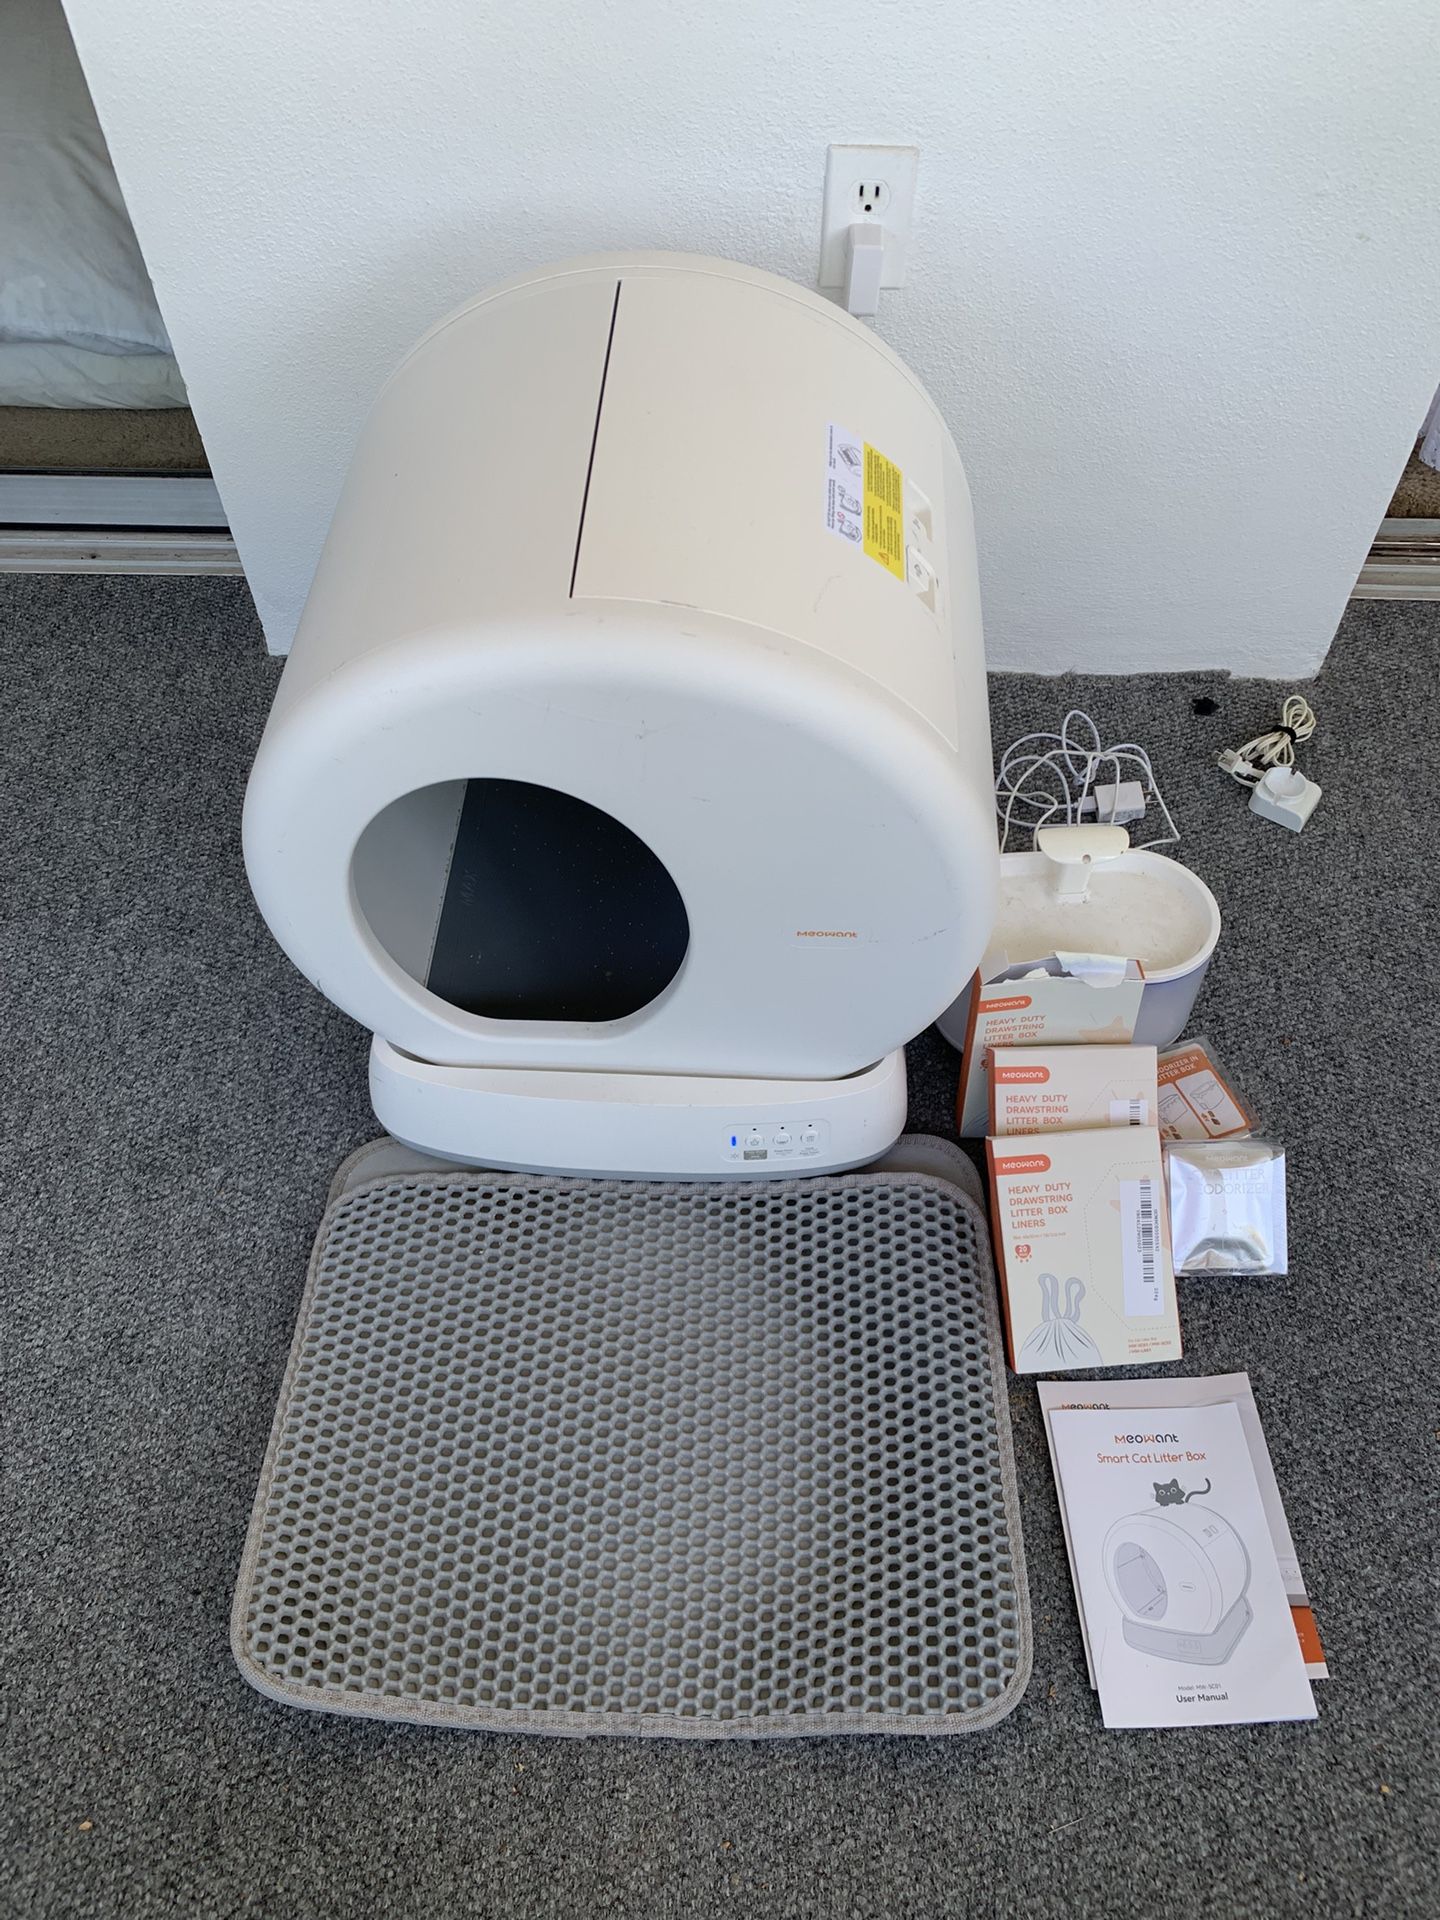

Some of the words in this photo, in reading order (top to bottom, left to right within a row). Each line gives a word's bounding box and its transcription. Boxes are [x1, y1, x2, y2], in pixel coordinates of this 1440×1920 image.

[986, 1017, 1016, 1026] HEAVY
[1021, 1015, 1046, 1023] DUTY
[985, 1023, 1045, 1034] DRAWSTRING
[984, 1033, 1014, 1042] LITTER
[1018, 1031, 1038, 1039] BOX
[1180, 1063, 1196, 1072] BOX
[1006, 1095, 1037, 1103] HEAVY
[1042, 1094, 1068, 1103] DUTY
[1006, 1105, 1069, 1114] DRAWSTRING
[1006, 1116, 1038, 1125] LITTER
[1043, 1116, 1063, 1125] BOX
[1006, 1127, 1040, 1135] LINERS
[1008, 1185, 1040, 1195] HEAVY
[1045, 1182, 1071, 1192] DUTY
[1009, 1193, 1073, 1206] DRAWSTRING
[1010, 1207, 1043, 1218] LITTER
[1048, 1205, 1069, 1215] BOX
[1012, 1219, 1046, 1229] LINERS
[1096, 1452, 1130, 1464] Smart
[1131, 1453, 1152, 1463] Cat
[1153, 1452, 1184, 1463] Litter
[1185, 1450, 1207, 1461] Box
[1176, 1695, 1195, 1703] User
[1197, 1692, 1229, 1702] Manual
